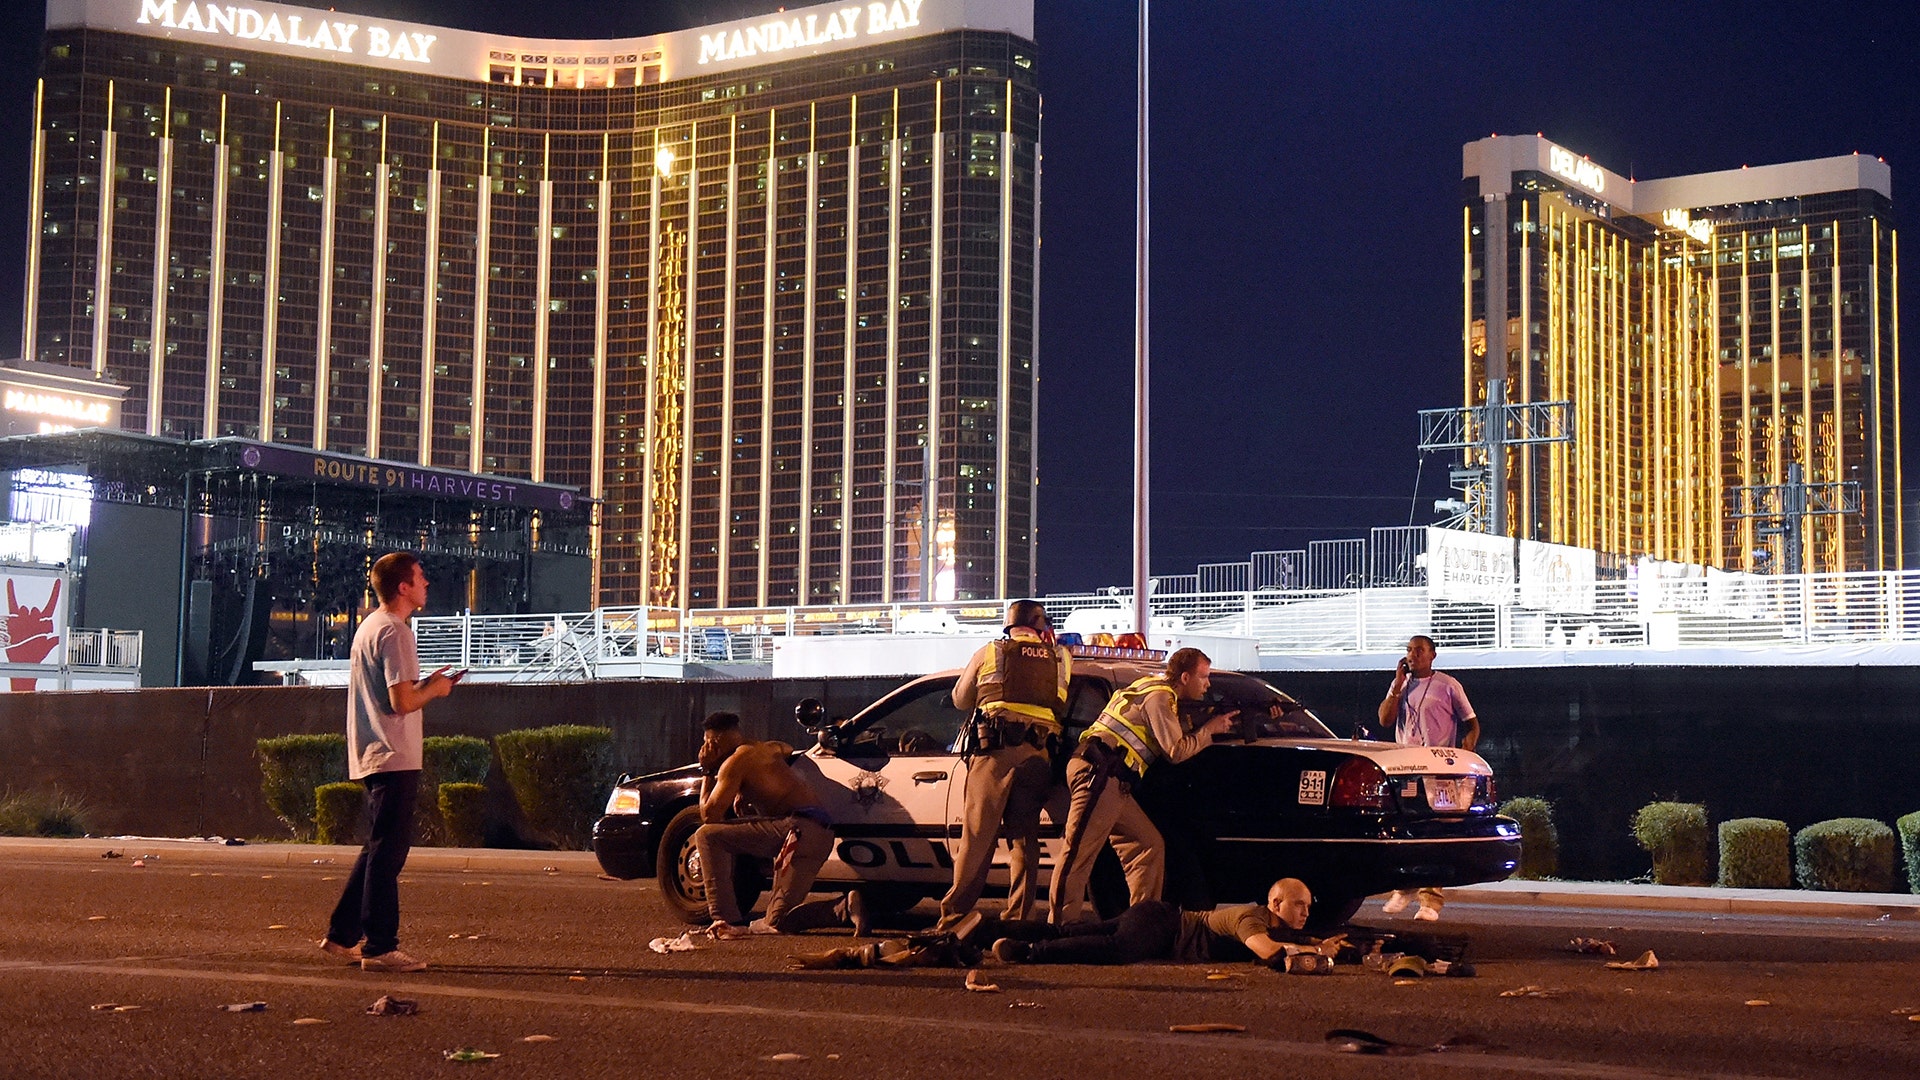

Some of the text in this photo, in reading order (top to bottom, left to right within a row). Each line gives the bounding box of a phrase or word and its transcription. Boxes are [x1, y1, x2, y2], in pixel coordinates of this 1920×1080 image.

[137, 0, 437, 63] MANDALAY BAY
[698, 0, 922, 64] MANDALAY BAY
[1550, 145, 1605, 193] DELANO
[4, 389, 111, 423] MANDALAY
[313, 458, 518, 502] ROUTE 91 HARVEST
[1452, 572, 1496, 585] HARVEST
[1021, 646, 1049, 659] POLICE
[1430, 749, 1459, 759] POLICE
